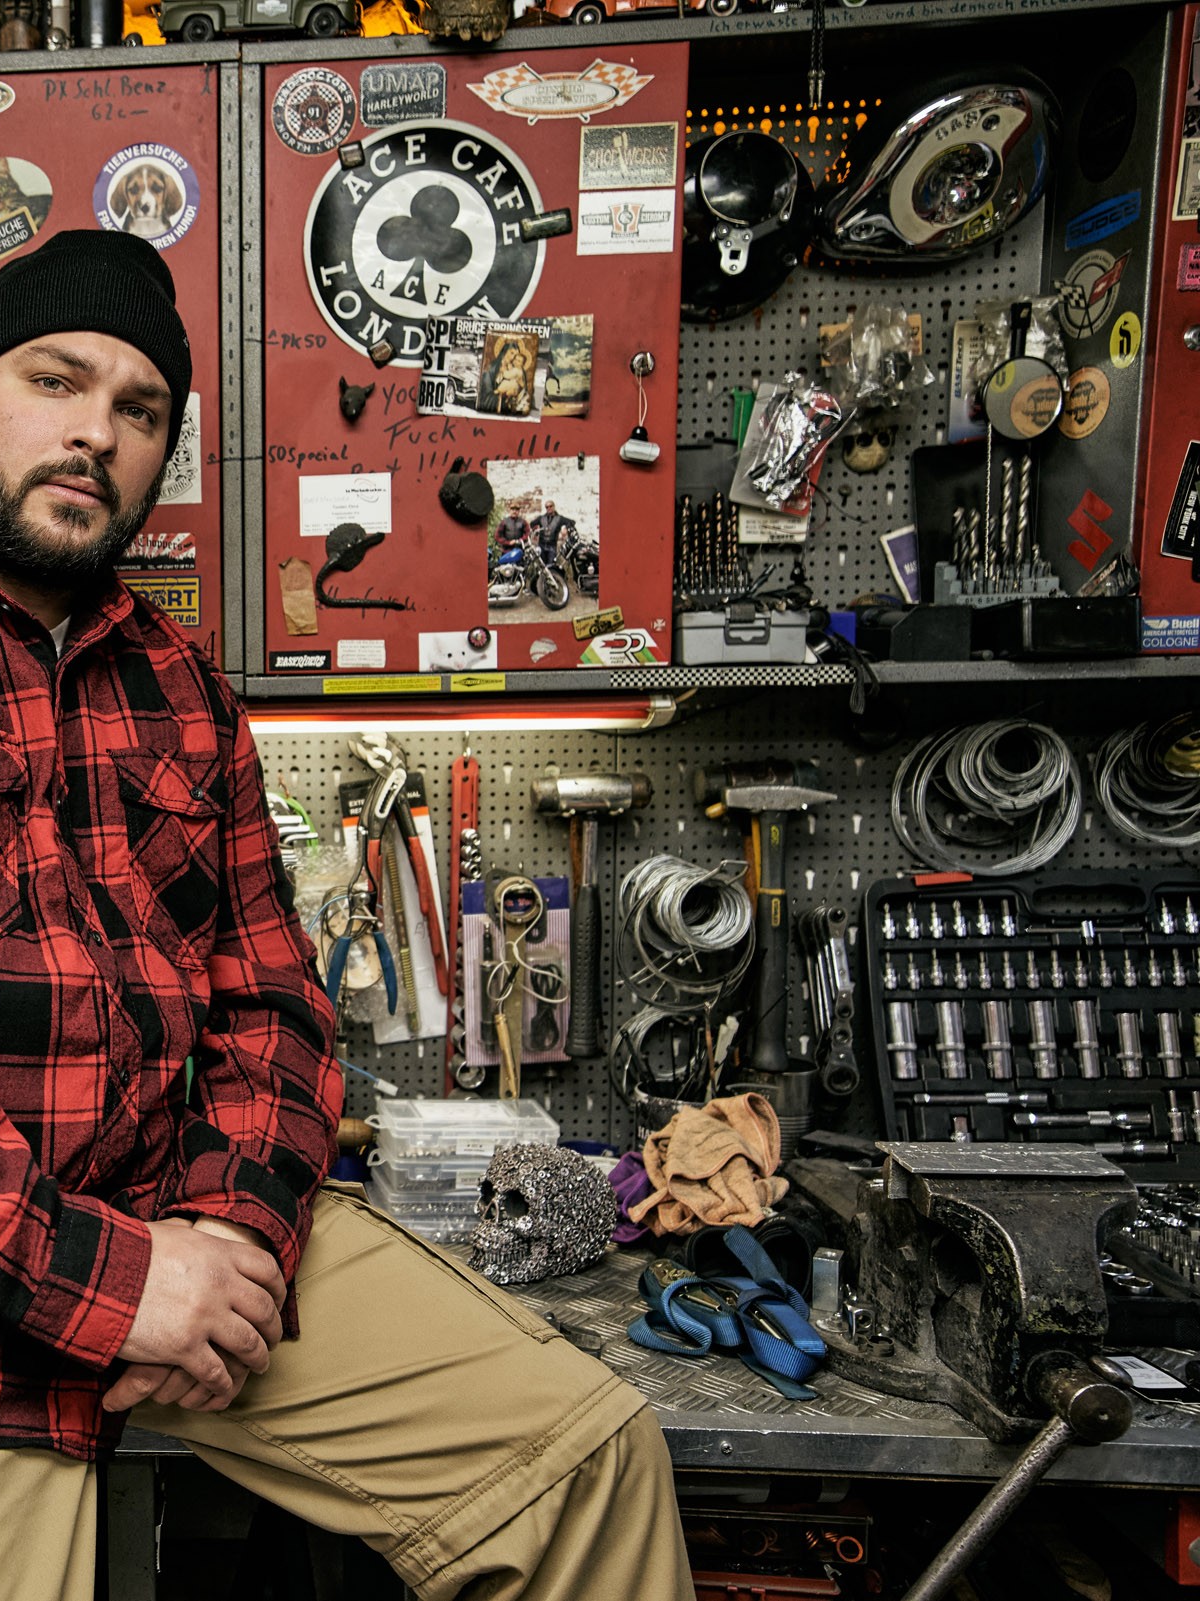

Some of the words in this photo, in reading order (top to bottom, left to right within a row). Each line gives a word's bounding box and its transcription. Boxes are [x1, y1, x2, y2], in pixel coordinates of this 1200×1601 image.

[367, 72, 440, 93] UMAP
[307, 106, 320, 118] 91
[366, 88, 439, 113] HARLEYWORLD
[276, 123, 311, 153] NORTH
[323, 121, 351, 150] WEST
[102, 143, 189, 176] TIERVERSUCHE?
[341, 132, 427, 205] ACE
[175, 204, 198, 239] HUND!
[319, 260, 501, 356] LONDN
[455, 318, 487, 335] BRUCE
[1177, 523, 1189, 541] CITY
[1171, 618, 1200, 630] Buell
[1142, 636, 1200, 649] COLOGNE
